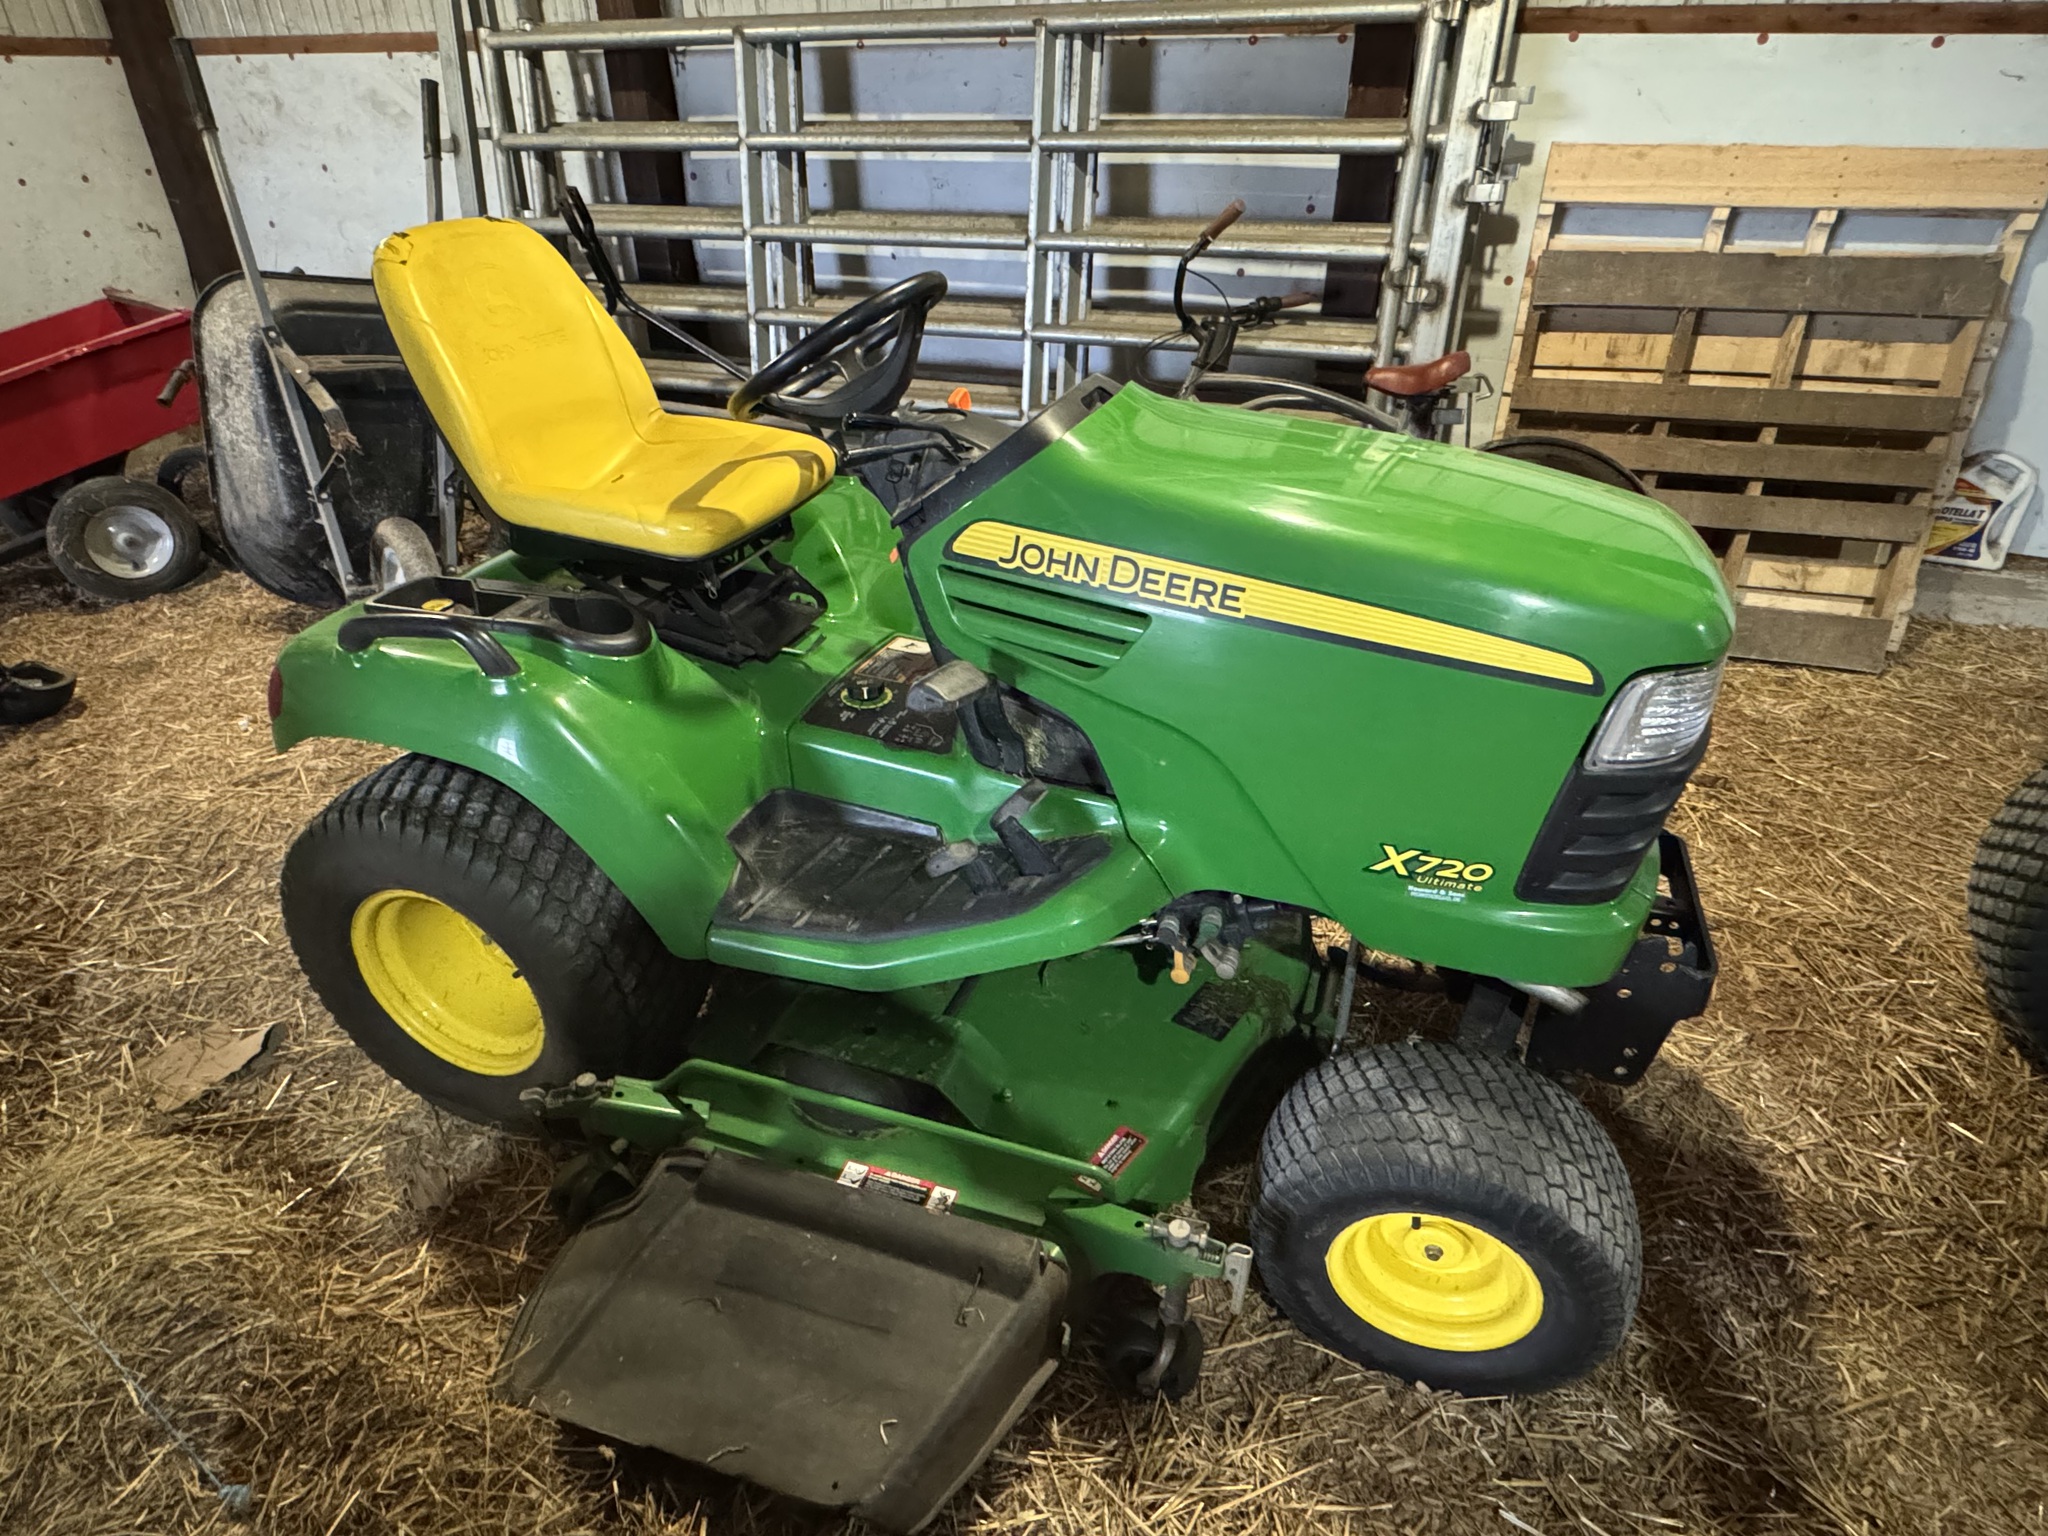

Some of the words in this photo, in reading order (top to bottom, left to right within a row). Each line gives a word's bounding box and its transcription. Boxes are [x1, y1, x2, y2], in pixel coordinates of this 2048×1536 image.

[1940, 506, 1978, 518] OTELLA
[999, 534, 1100, 583] JOHN
[1108, 554, 1247, 613] DEERE
[1366, 843, 1495, 883] X720
[1416, 875, 1483, 892] Ultimate
